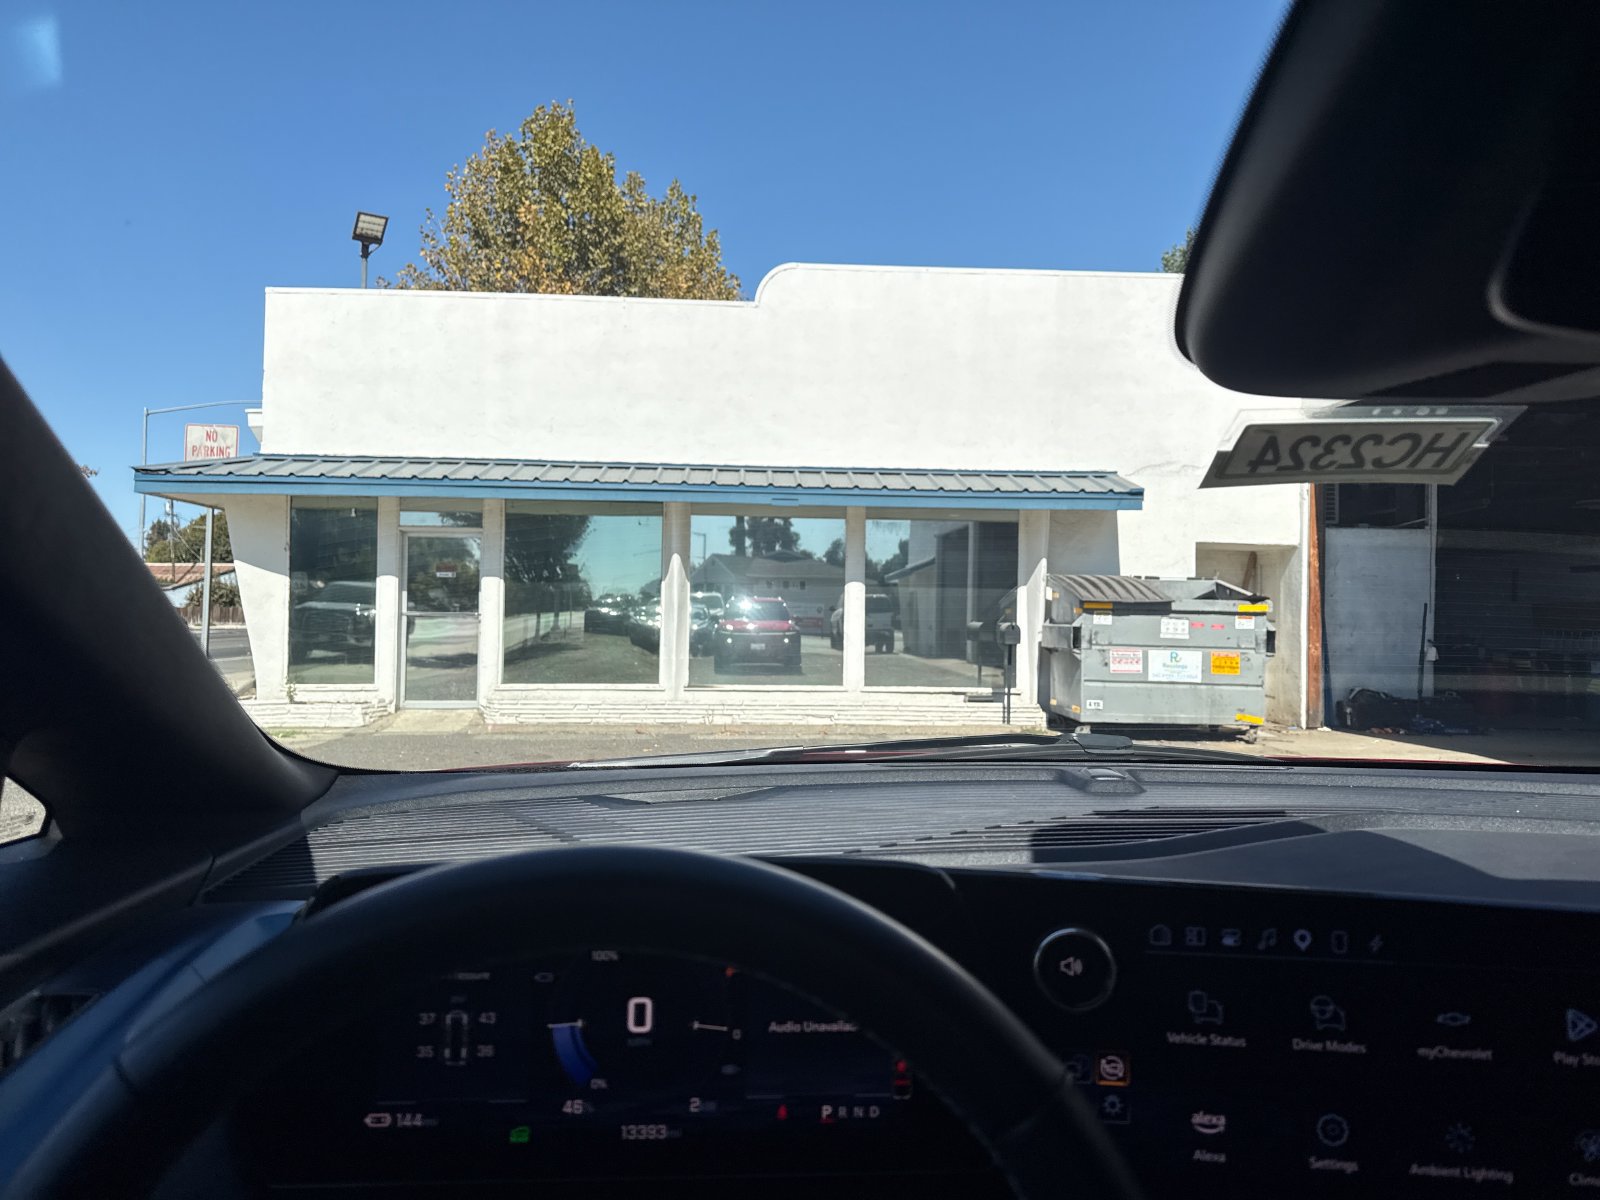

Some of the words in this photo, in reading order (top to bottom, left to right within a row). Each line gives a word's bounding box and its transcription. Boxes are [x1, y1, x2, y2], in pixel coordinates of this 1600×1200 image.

[205, 429, 218, 442] NO
[192, 444, 231, 459] PARKING
[479, 1012, 497, 1024] 43
[627, 997, 653, 1033] 0
[768, 1020, 801, 1033] Audio
[1166, 1031, 1207, 1045] Vehicle
[1209, 1033, 1246, 1047] Status
[1292, 1038, 1323, 1051] Drive
[1325, 1040, 1366, 1054] Modes
[1553, 1051, 1579, 1068] Play
[821, 1105, 832, 1119] P
[838, 1106, 848, 1119] R
[853, 1106, 864, 1118] N
[869, 1106, 880, 1118] D
[1193, 1150, 1226, 1162] Alexa
[1309, 1155, 1359, 1174] Settings
